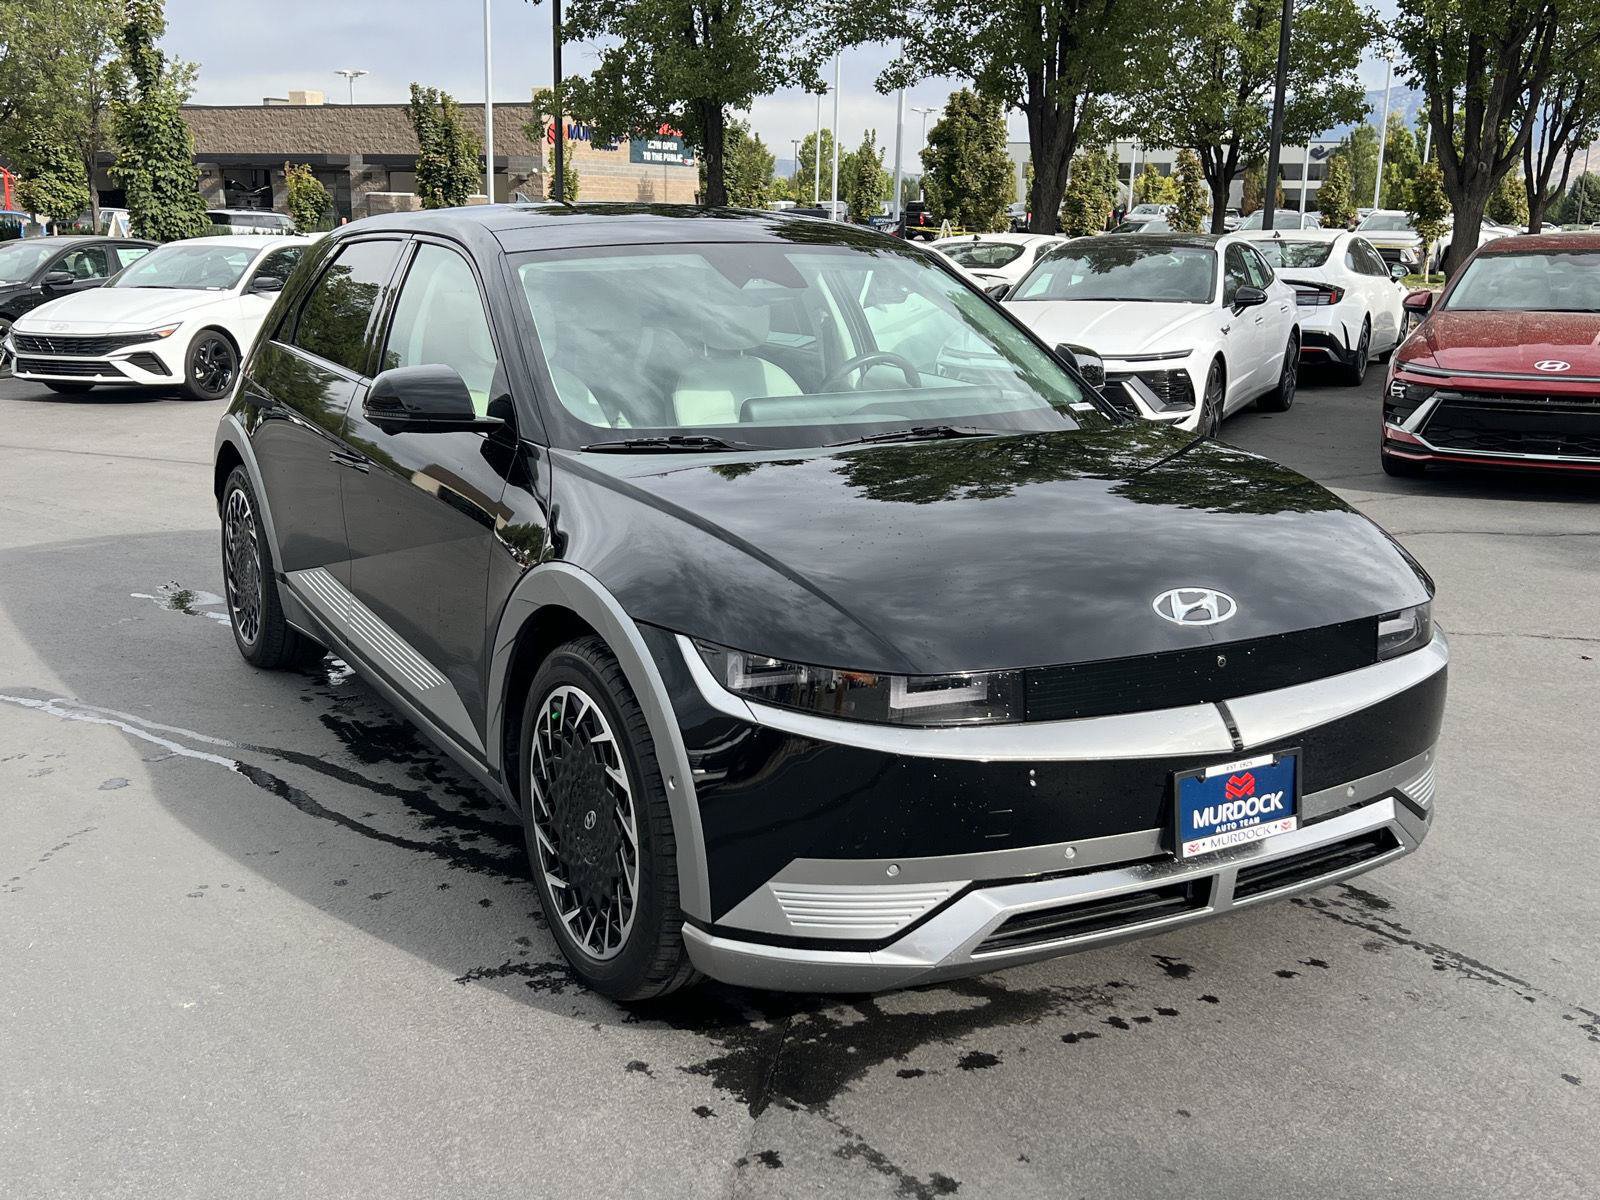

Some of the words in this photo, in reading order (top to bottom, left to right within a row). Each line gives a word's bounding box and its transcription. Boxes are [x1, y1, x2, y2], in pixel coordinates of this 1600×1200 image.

[642, 151, 652, 161] TO
[651, 151, 663, 162] THE
[663, 153, 684, 163] PUBLIC
[1193, 790, 1284, 829] MURDOCK
[1215, 821, 1237, 833] AUTO
[1238, 816, 1260, 828] TEAM
[1210, 825, 1271, 848] MURDOCK
